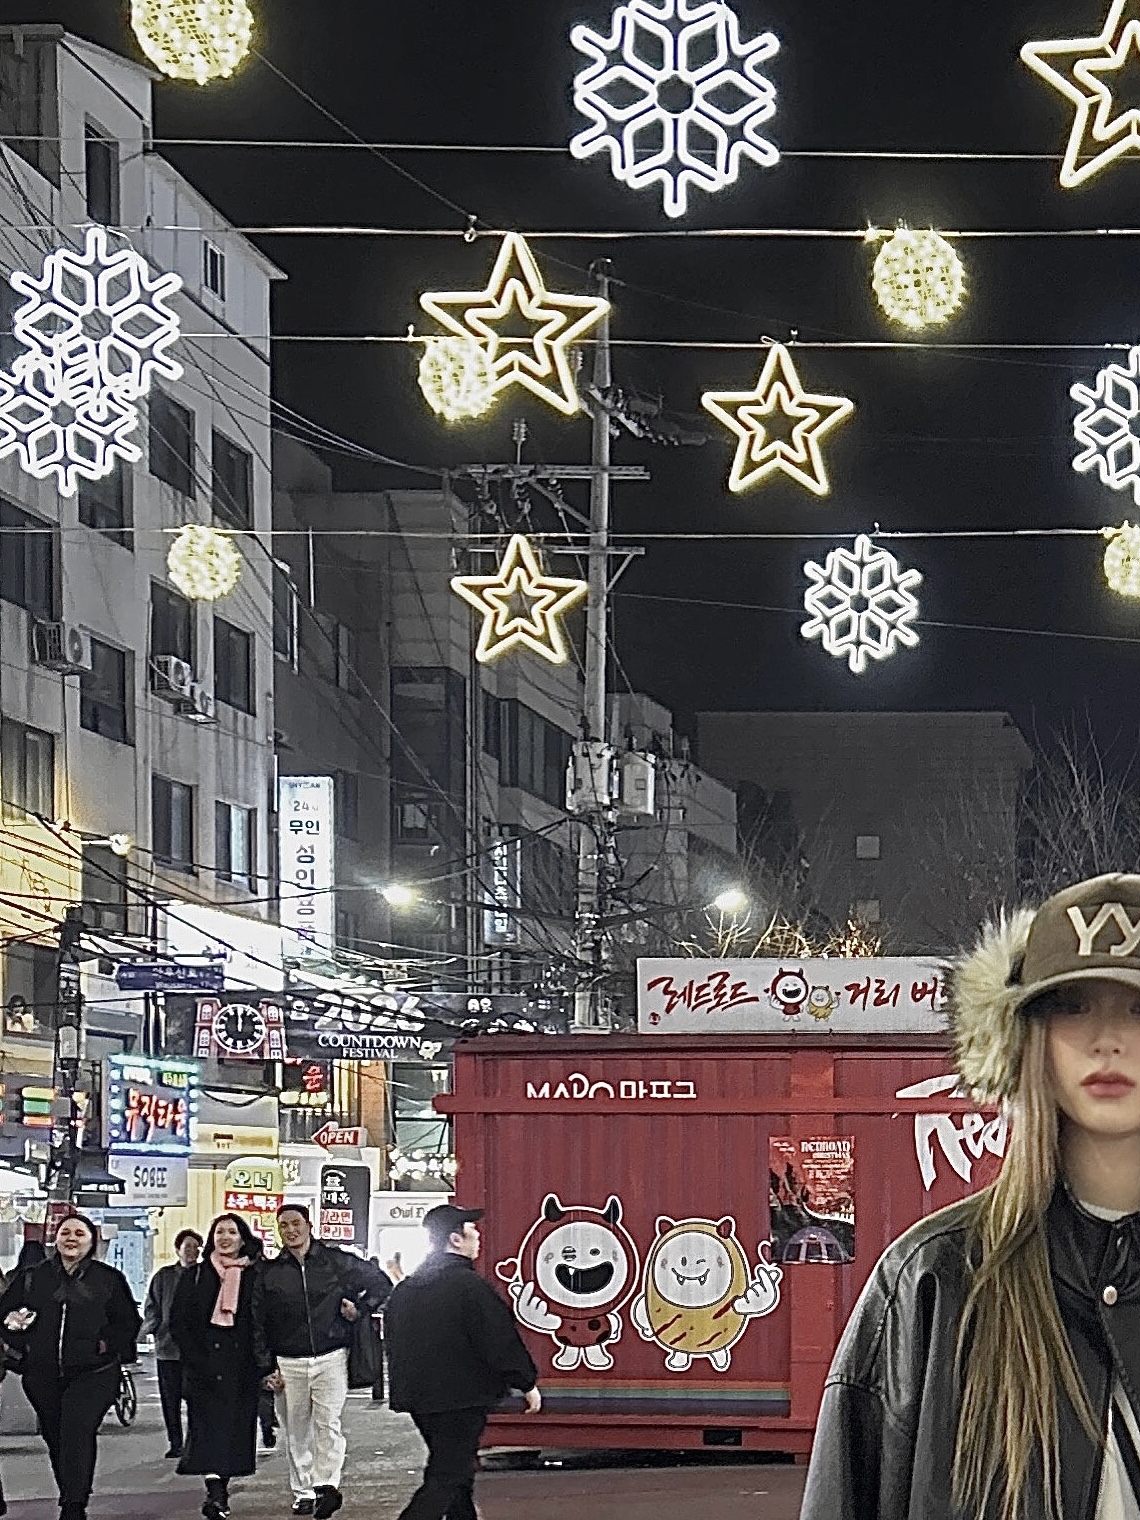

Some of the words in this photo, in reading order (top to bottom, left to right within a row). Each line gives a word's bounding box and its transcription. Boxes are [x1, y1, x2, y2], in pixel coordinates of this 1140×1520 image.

[289, 819, 320, 836] 무인
[647, 971, 759, 1015] 레드로드
[844, 976, 900, 1011] 거리
[911, 976, 946, 1011] 버
[318, 1034, 421, 1049] COUNTDOWN
[342, 1048, 399, 1059] FESTIVAL
[319, 1130, 355, 1145] OPEN
